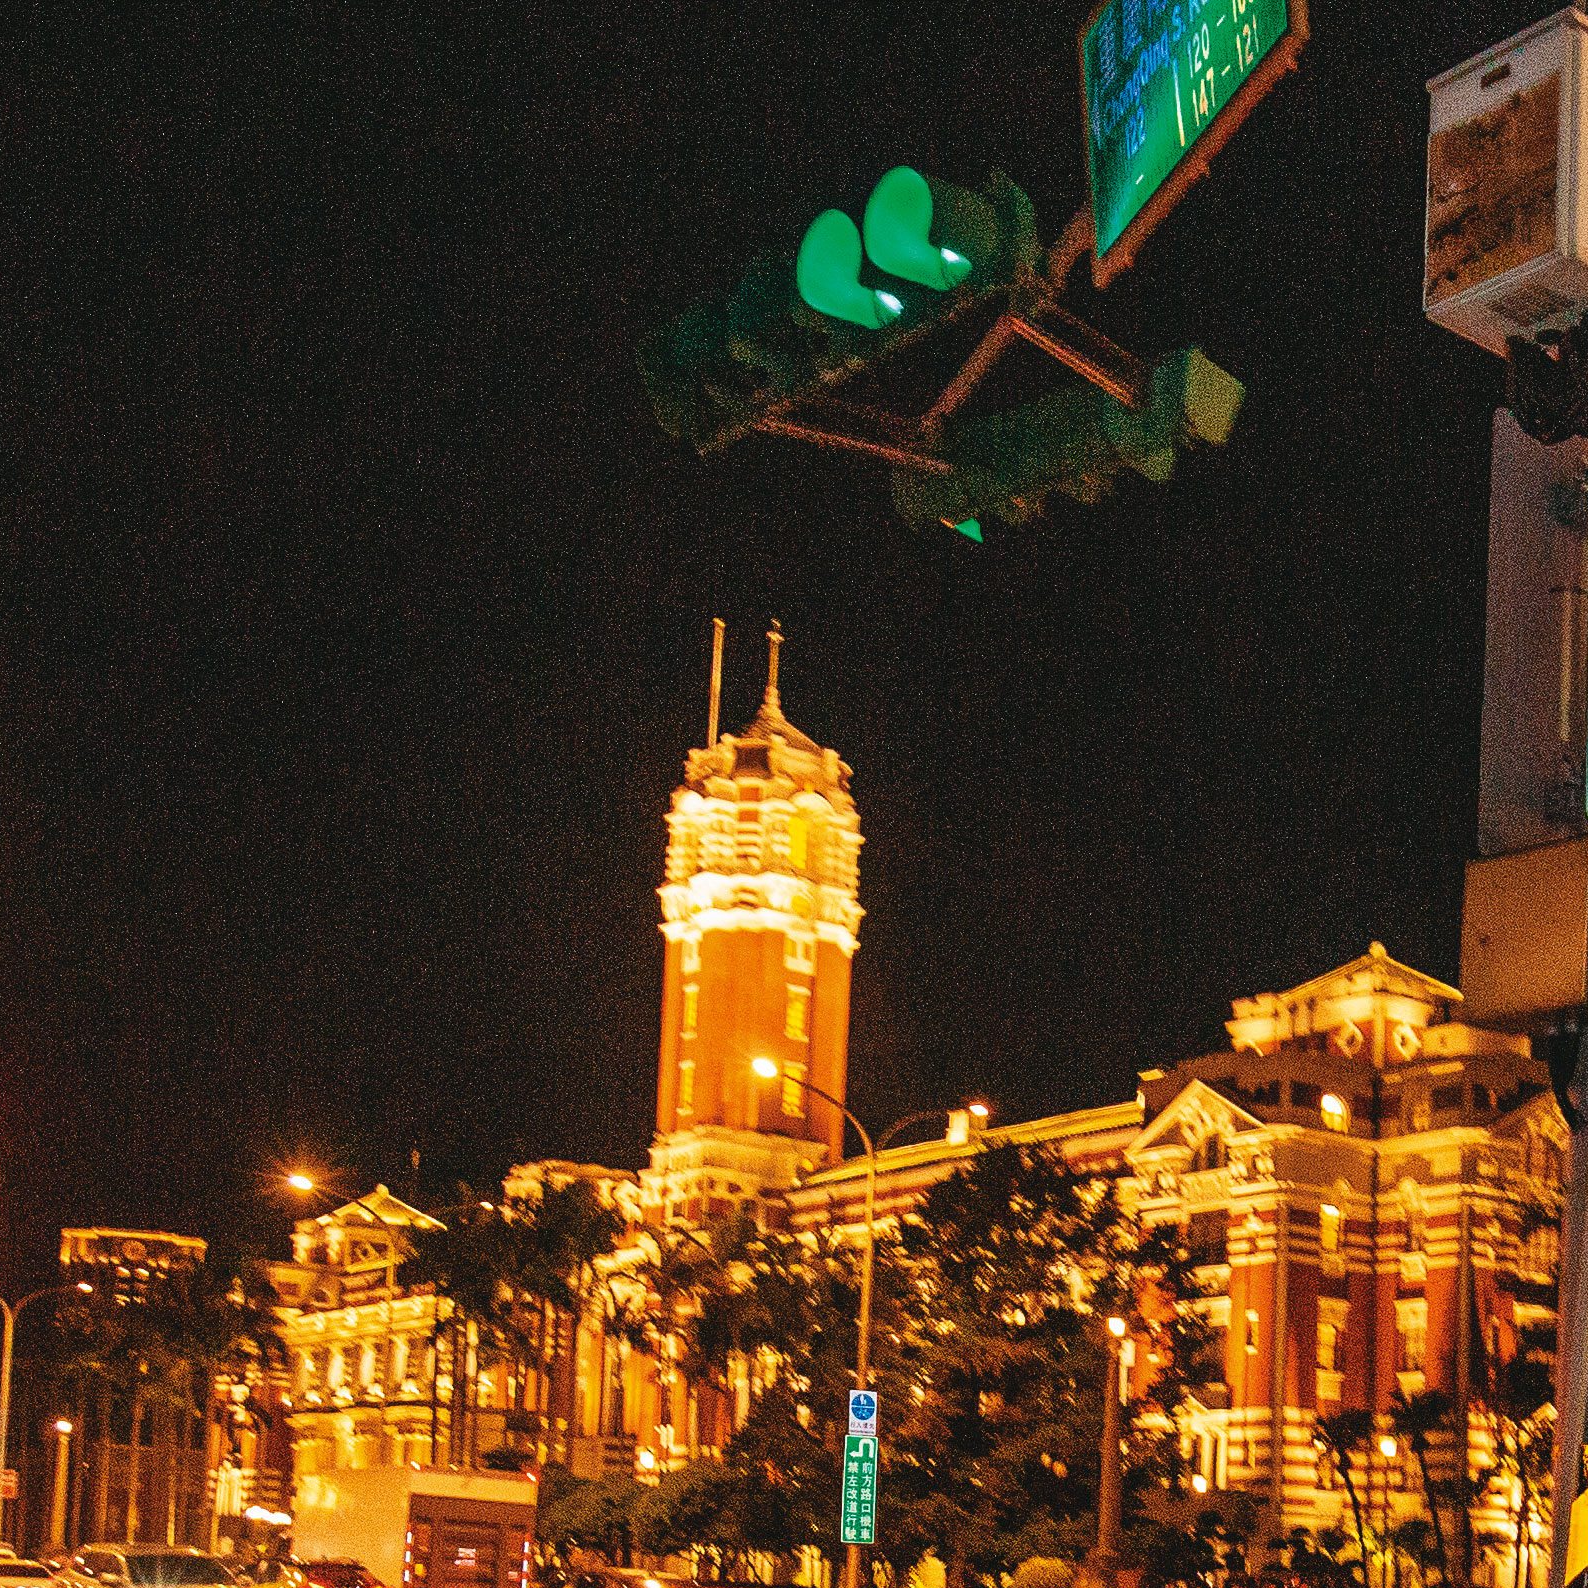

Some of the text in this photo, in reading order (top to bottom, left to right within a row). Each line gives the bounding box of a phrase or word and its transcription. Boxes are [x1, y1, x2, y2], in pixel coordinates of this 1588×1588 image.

[1187, 22, 1210, 79] 120
[1192, 67, 1216, 127] 147
[1236, 14, 1260, 73] 121
